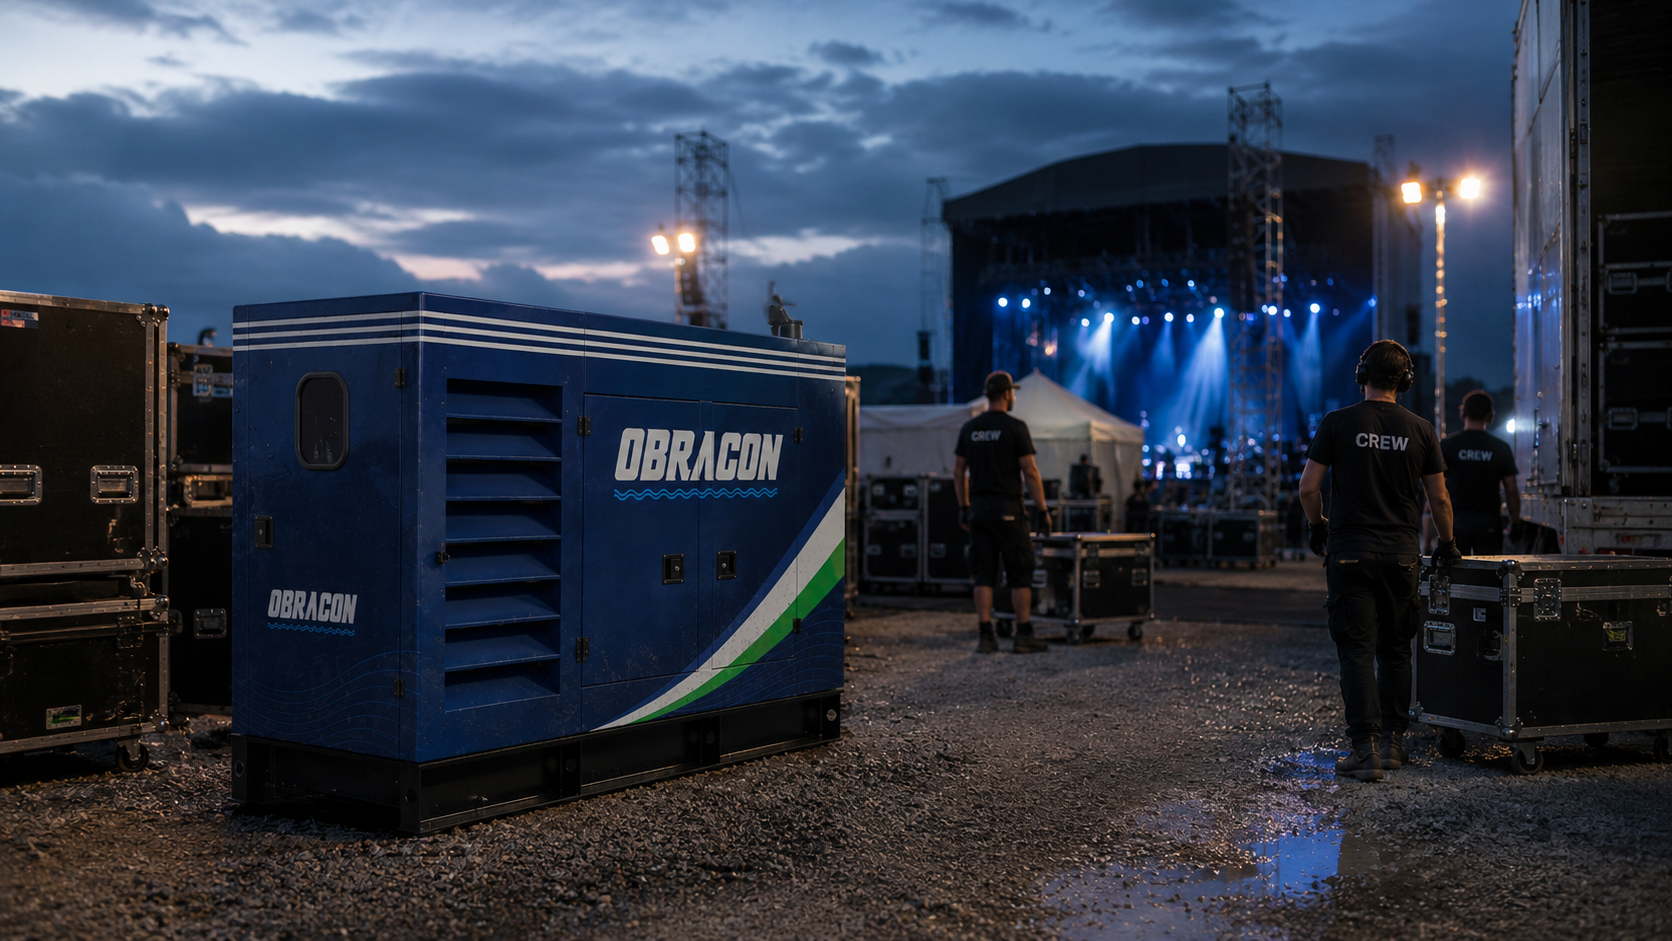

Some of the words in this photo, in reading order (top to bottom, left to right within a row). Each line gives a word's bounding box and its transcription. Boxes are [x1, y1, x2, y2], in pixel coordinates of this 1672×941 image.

[971, 430, 1002, 442] CREW
[1355, 433, 1410, 451] CREW
[614, 428, 784, 482] OBRACON
[1458, 449, 1493, 462] CREW
[267, 589, 357, 624] OBRACON
